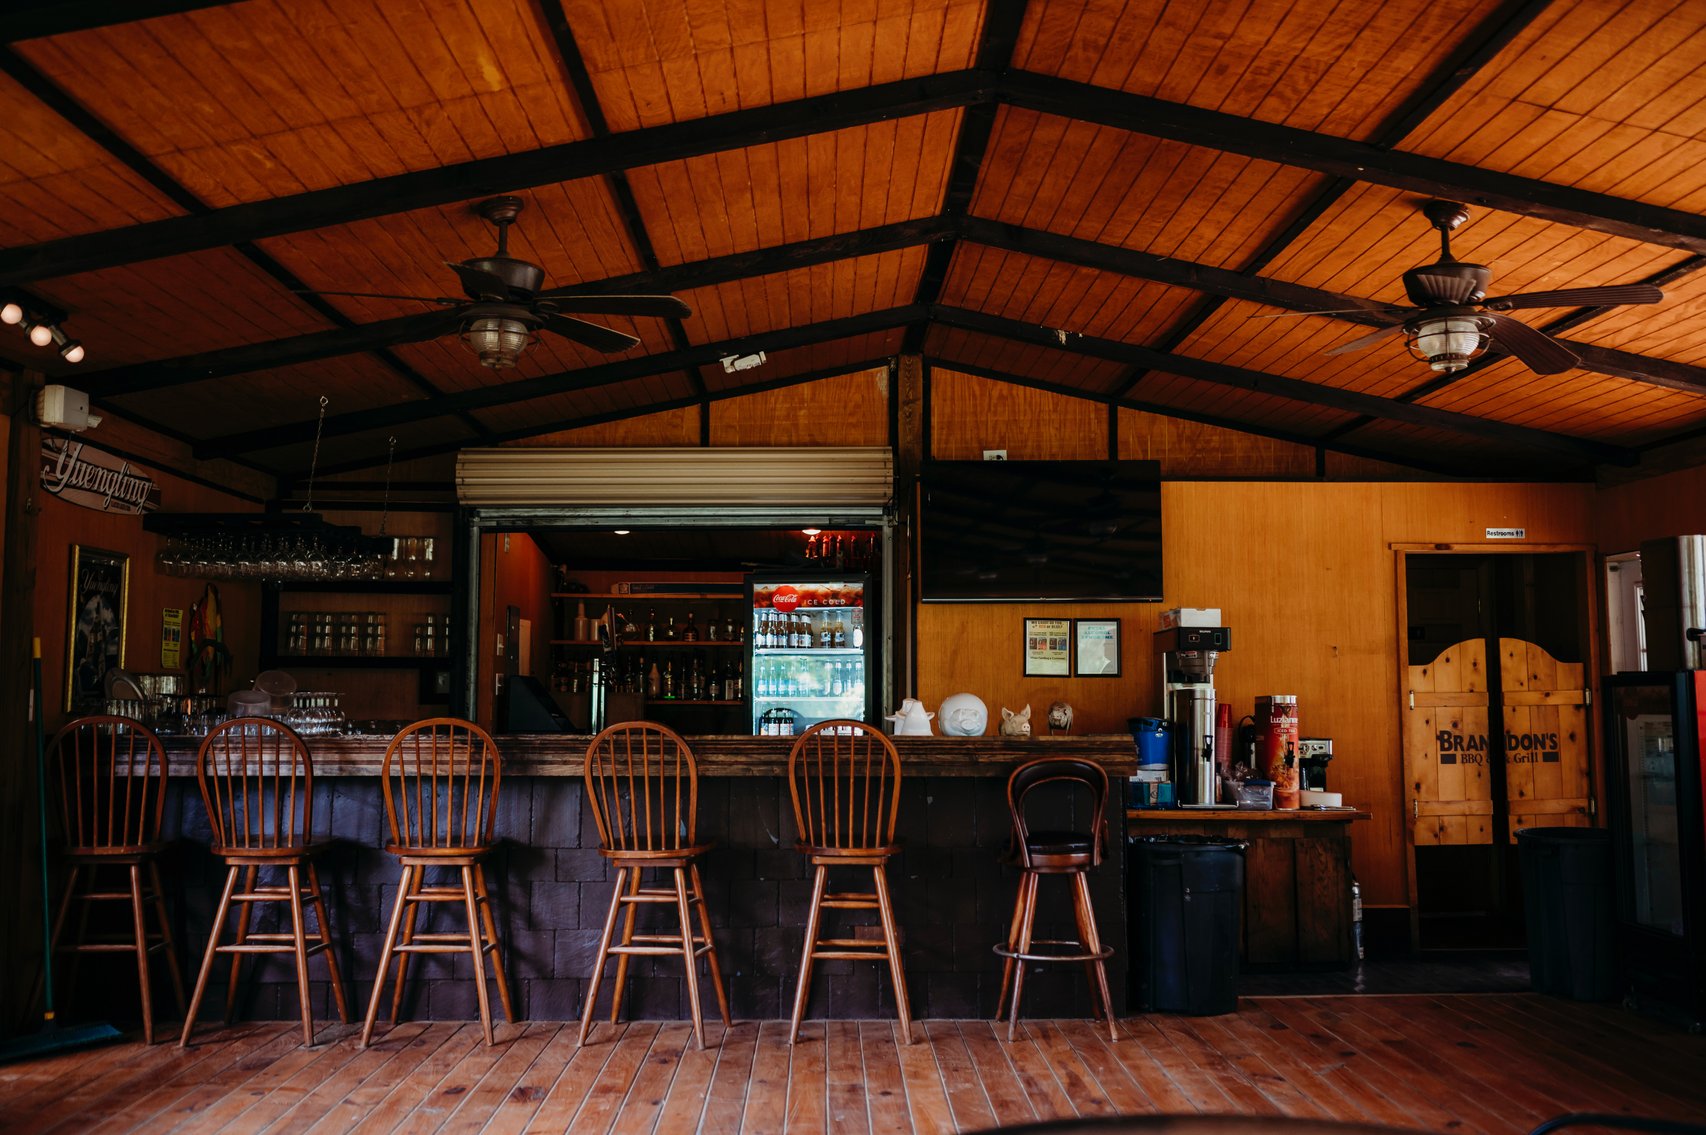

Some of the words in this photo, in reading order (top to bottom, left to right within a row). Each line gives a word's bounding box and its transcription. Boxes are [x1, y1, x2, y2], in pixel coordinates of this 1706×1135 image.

[44, 440, 153, 514] Yuengling
[1461, 753, 1483, 766] BBQ
[1513, 752, 1538, 763] Grill
